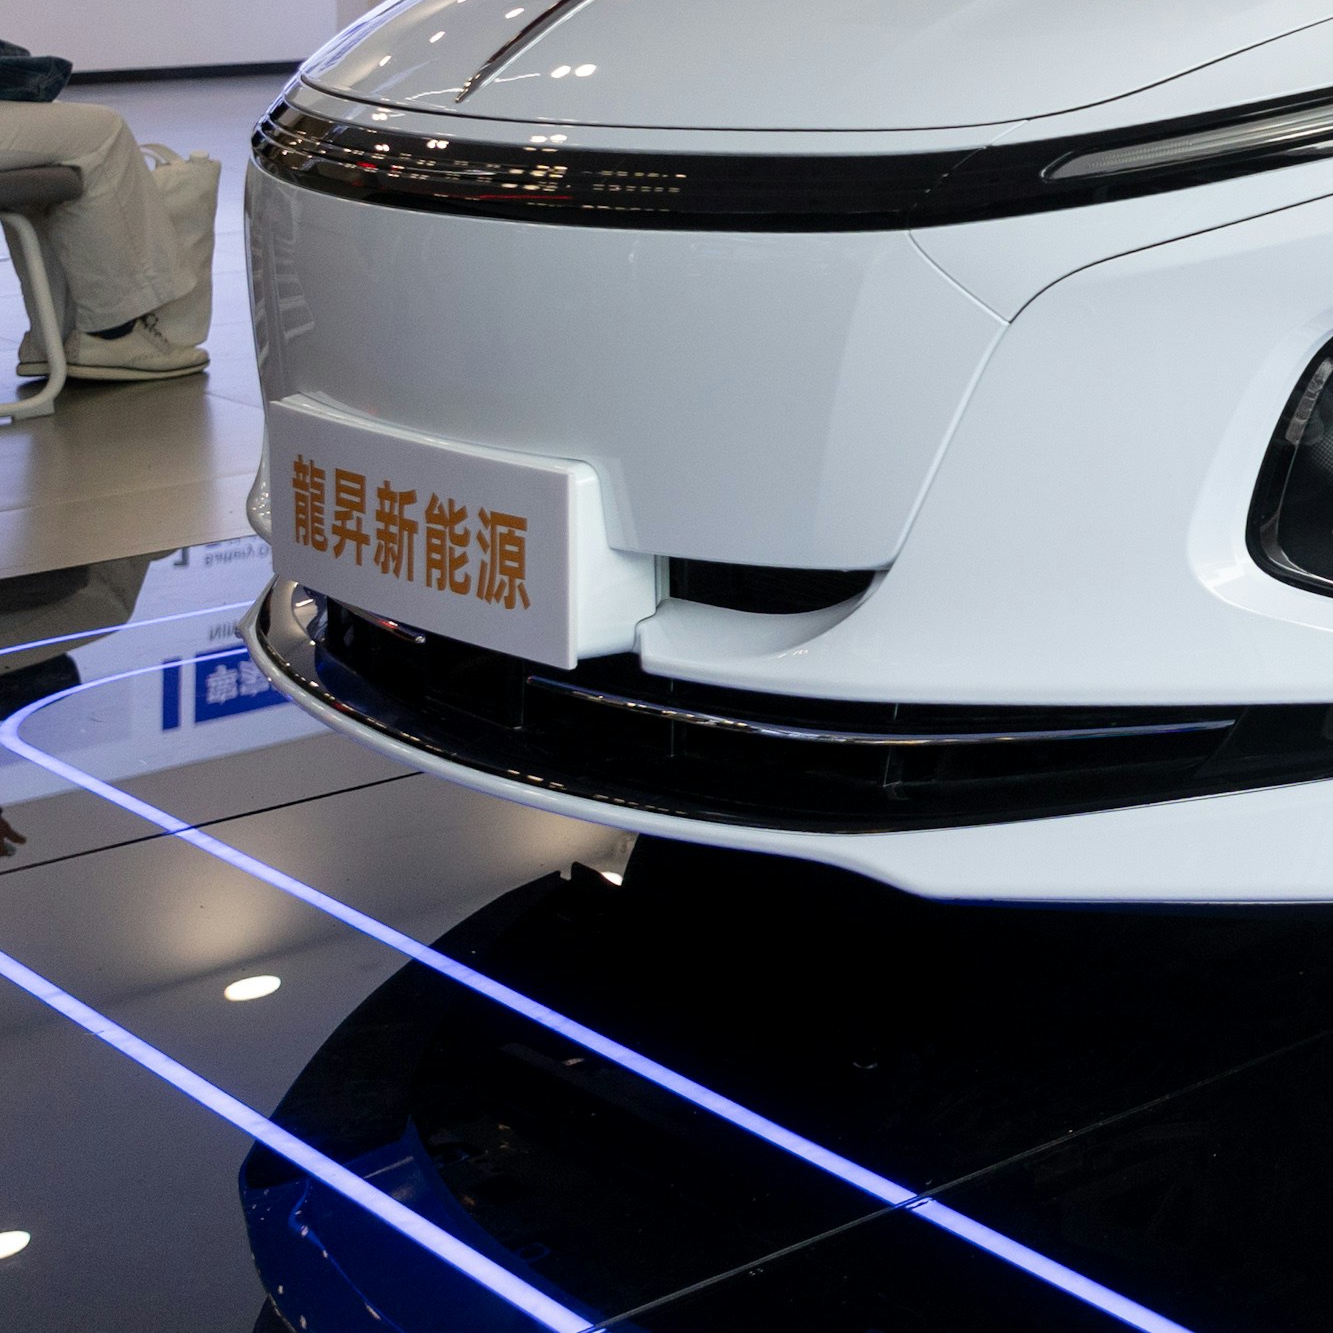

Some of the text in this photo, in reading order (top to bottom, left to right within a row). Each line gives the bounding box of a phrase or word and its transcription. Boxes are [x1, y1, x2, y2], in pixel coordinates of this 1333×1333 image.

[291, 453, 532, 611] 龍昇新能源
